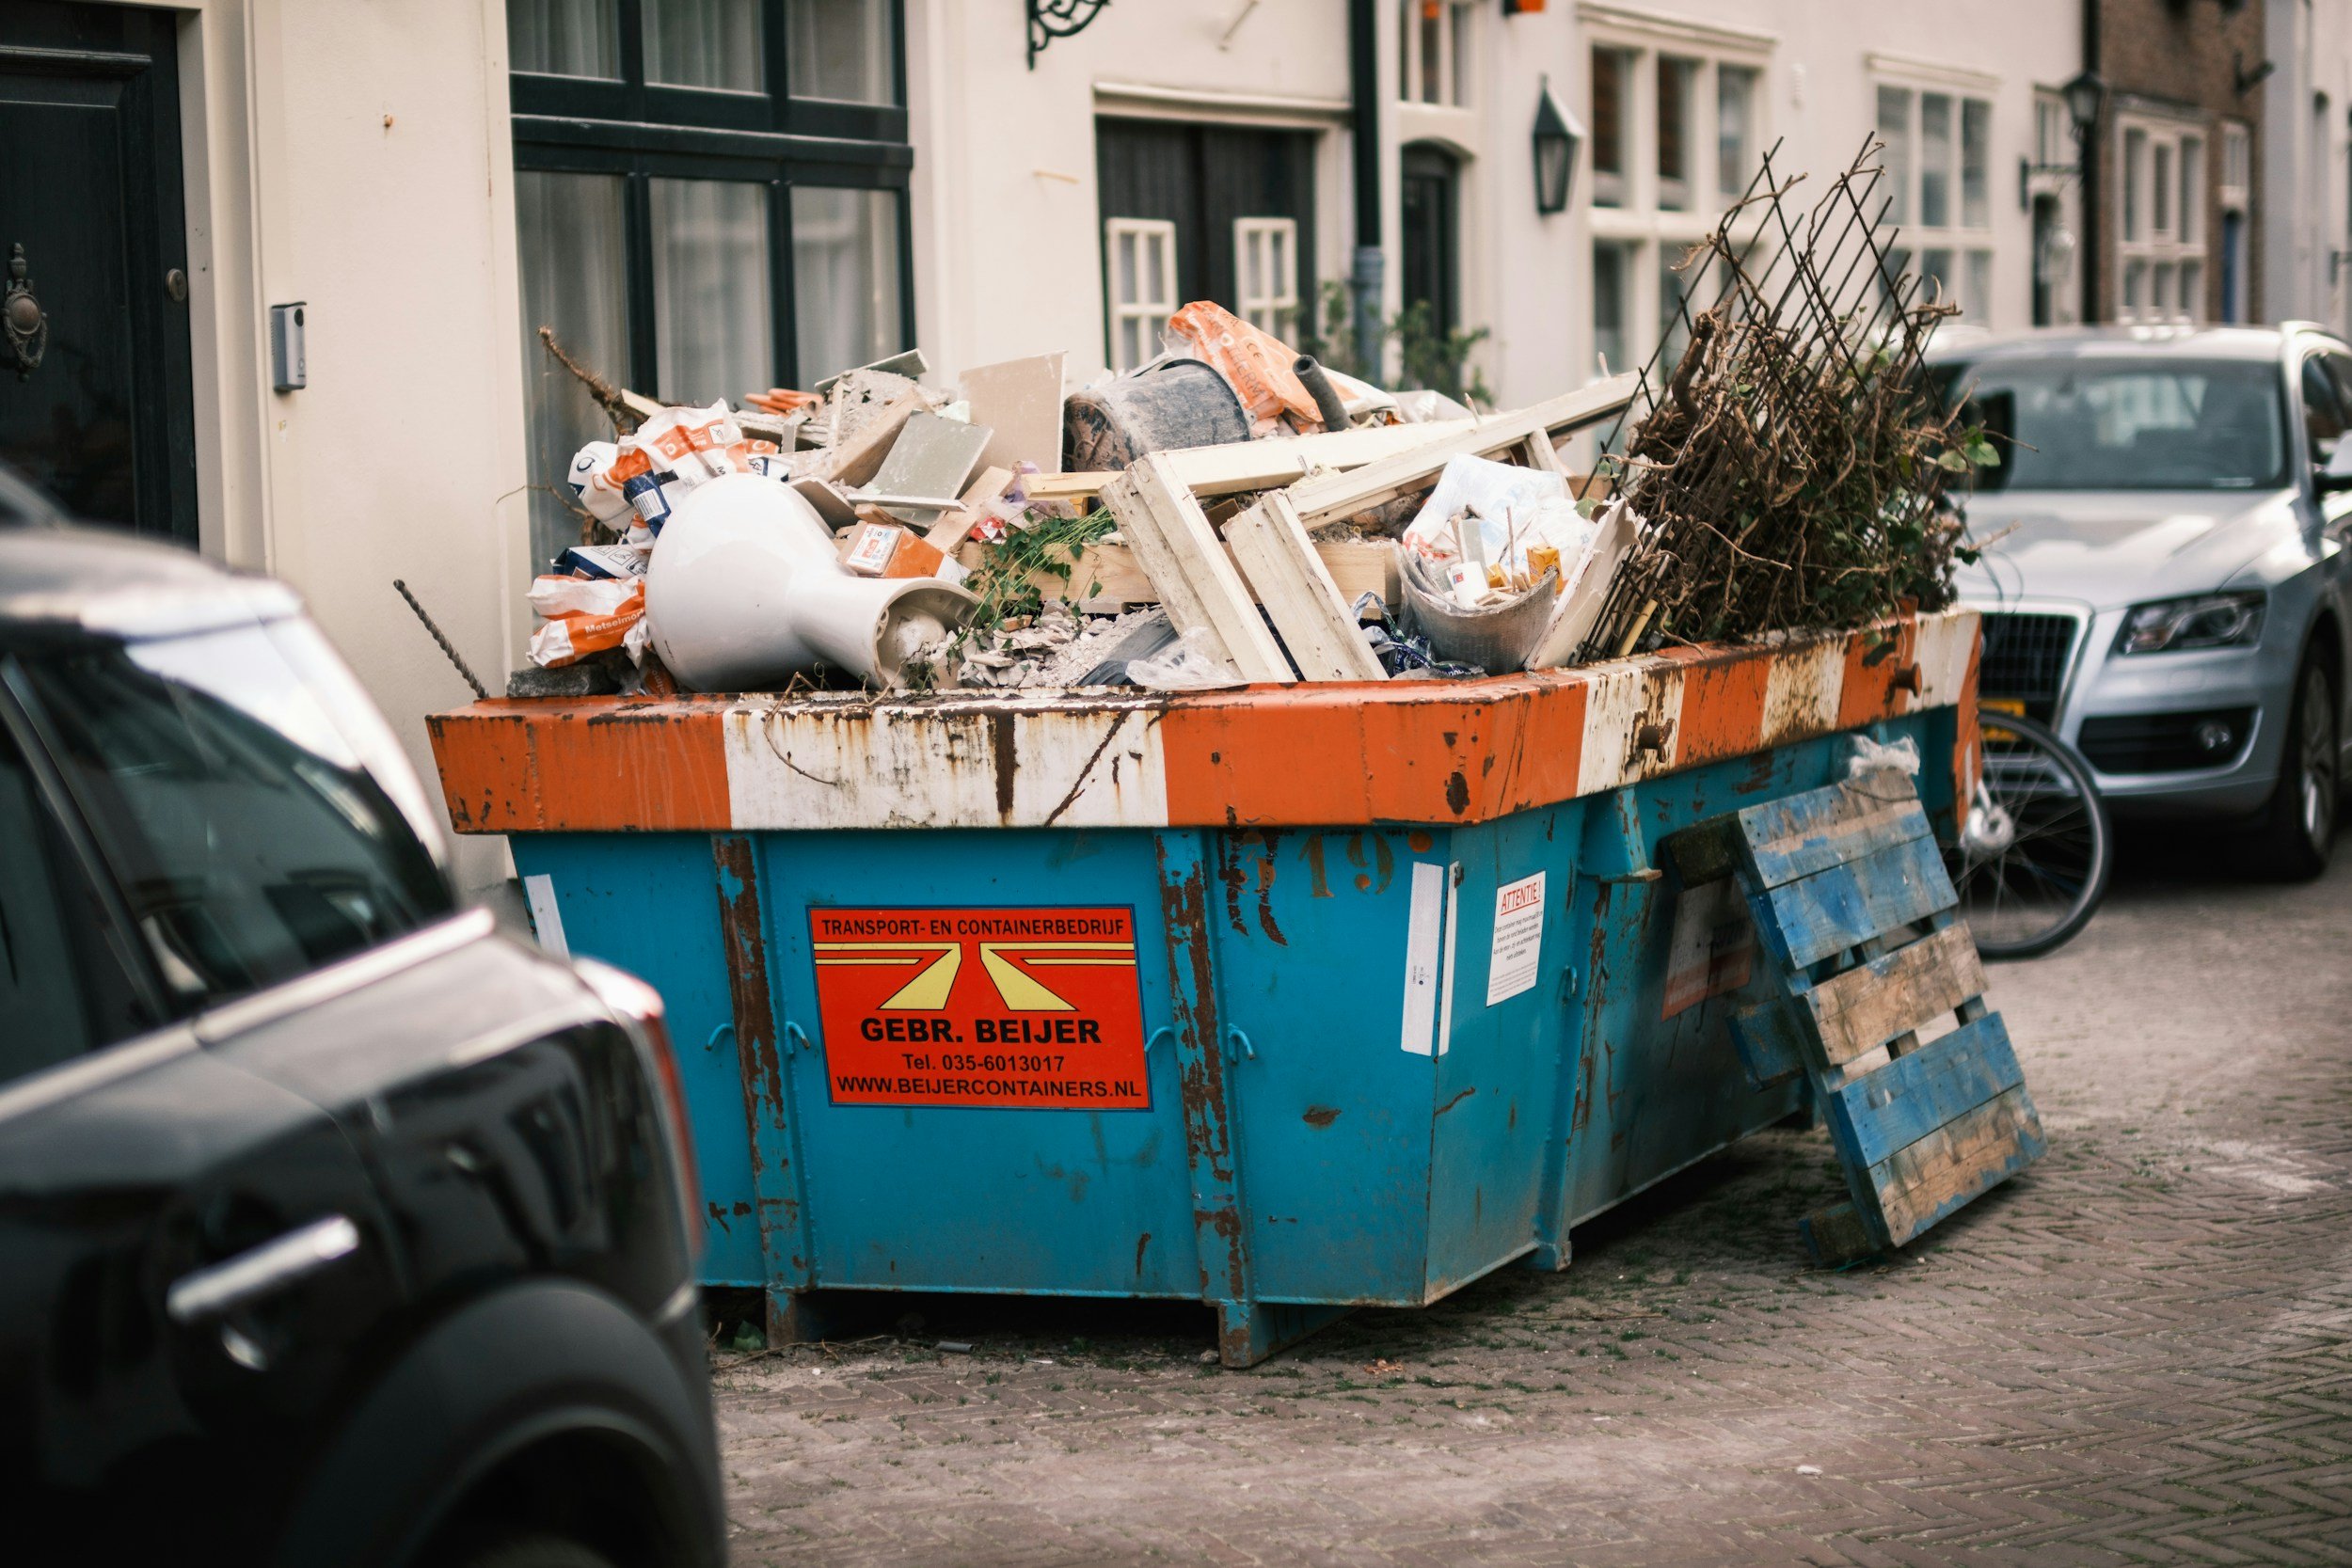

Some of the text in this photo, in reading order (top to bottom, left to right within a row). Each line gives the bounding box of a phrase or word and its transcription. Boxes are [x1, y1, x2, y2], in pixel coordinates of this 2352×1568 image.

[821, 919, 1124, 936] TRANSPORT- EN CONTAINERBEDRIJF
[860, 1017, 1103, 1045] GEBR. BEIJER
[901, 1053, 1065, 1072] Tel. 035-6013017
[835, 1075, 1142, 1098] WWW.BEIJERCONTAINERS.NL
